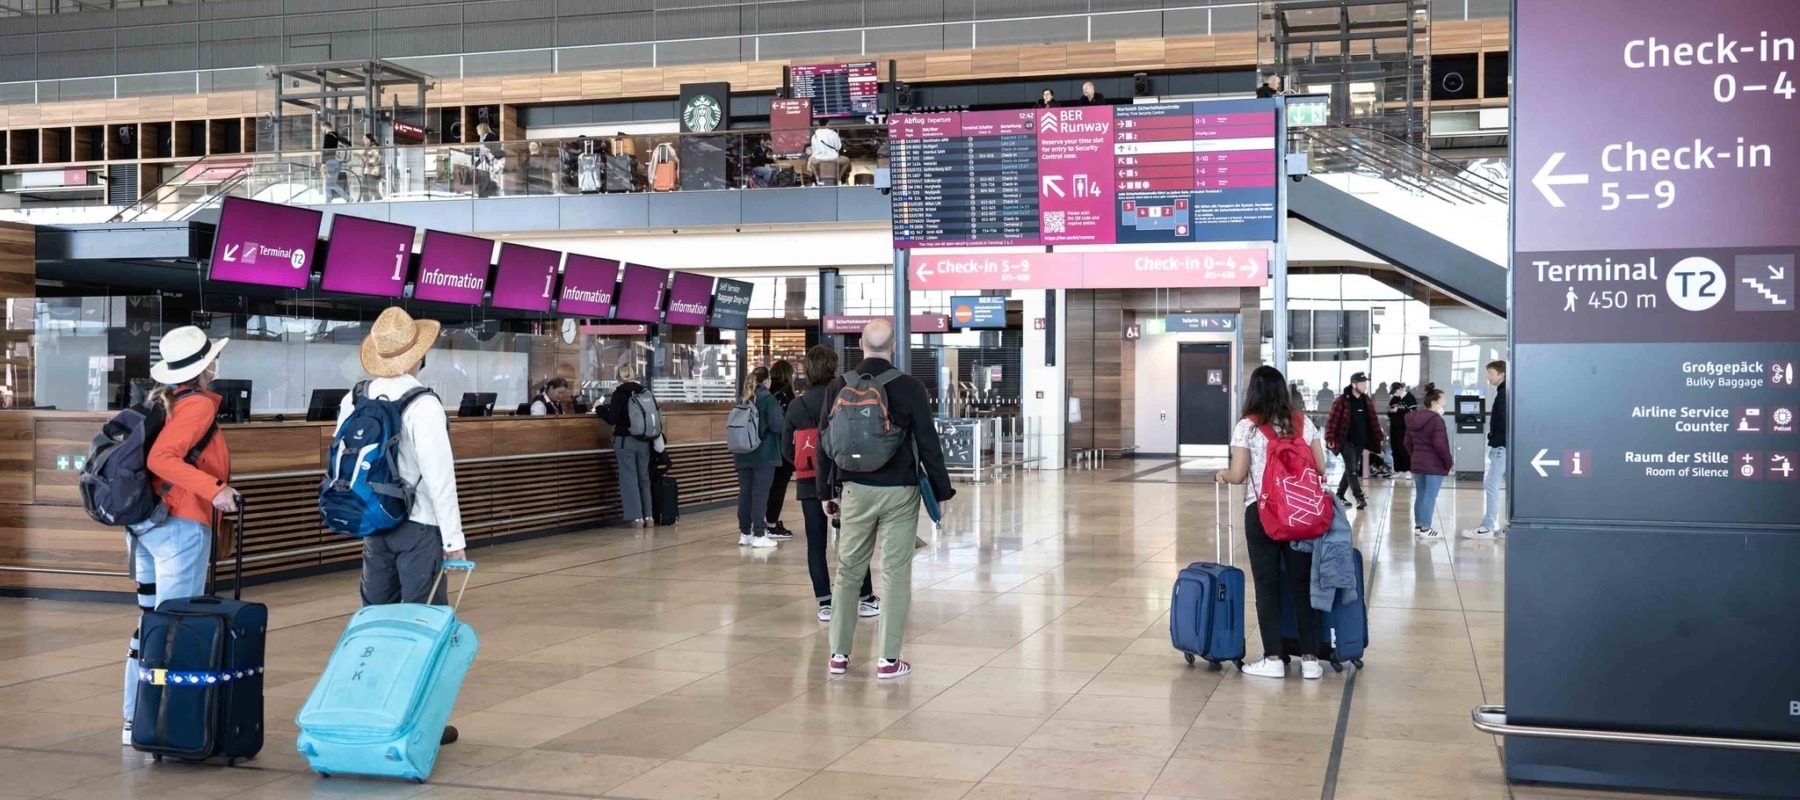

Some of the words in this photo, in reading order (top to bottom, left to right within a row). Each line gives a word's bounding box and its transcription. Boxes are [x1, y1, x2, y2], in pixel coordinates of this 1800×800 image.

[1623, 31, 1795, 68] Check-in
[1060, 110, 1082, 120] BER
[1060, 122, 1109, 134] Runway
[1601, 137, 1772, 172] Check-in
[1090, 181, 1101, 197] 4
[260, 244, 291, 258] Terminal
[293, 253, 304, 265] T2
[937, 260, 997, 273] Check-in
[1134, 256, 1199, 270] Check-in
[421, 268, 484, 290] Information
[1532, 257, 1658, 282] Terminal
[1674, 271, 1716, 298] T2
[563, 287, 610, 304] Information
[1588, 291, 1628, 309] 450
[1637, 293, 1656, 308] m
[670, 300, 707, 315] Information
[938, 318, 944, 328] 3
[1682, 361, 1763, 376] Großgepäck
[1686, 377, 1715, 389] Bulky
[1718, 377, 1763, 389] Baggage
[1632, 406, 1677, 418] Airline
[1680, 406, 1729, 418] Service
[1675, 420, 1729, 432] Counter
[1625, 452, 1664, 463] Raum
[1668, 451, 1690, 463] der
[1694, 451, 1729, 463] Stille
[1646, 467, 1676, 476] Room
[1679, 467, 1689, 476] of
[1692, 467, 1728, 477] Silence
[360, 646, 375, 657] B
[352, 670, 364, 680] K
